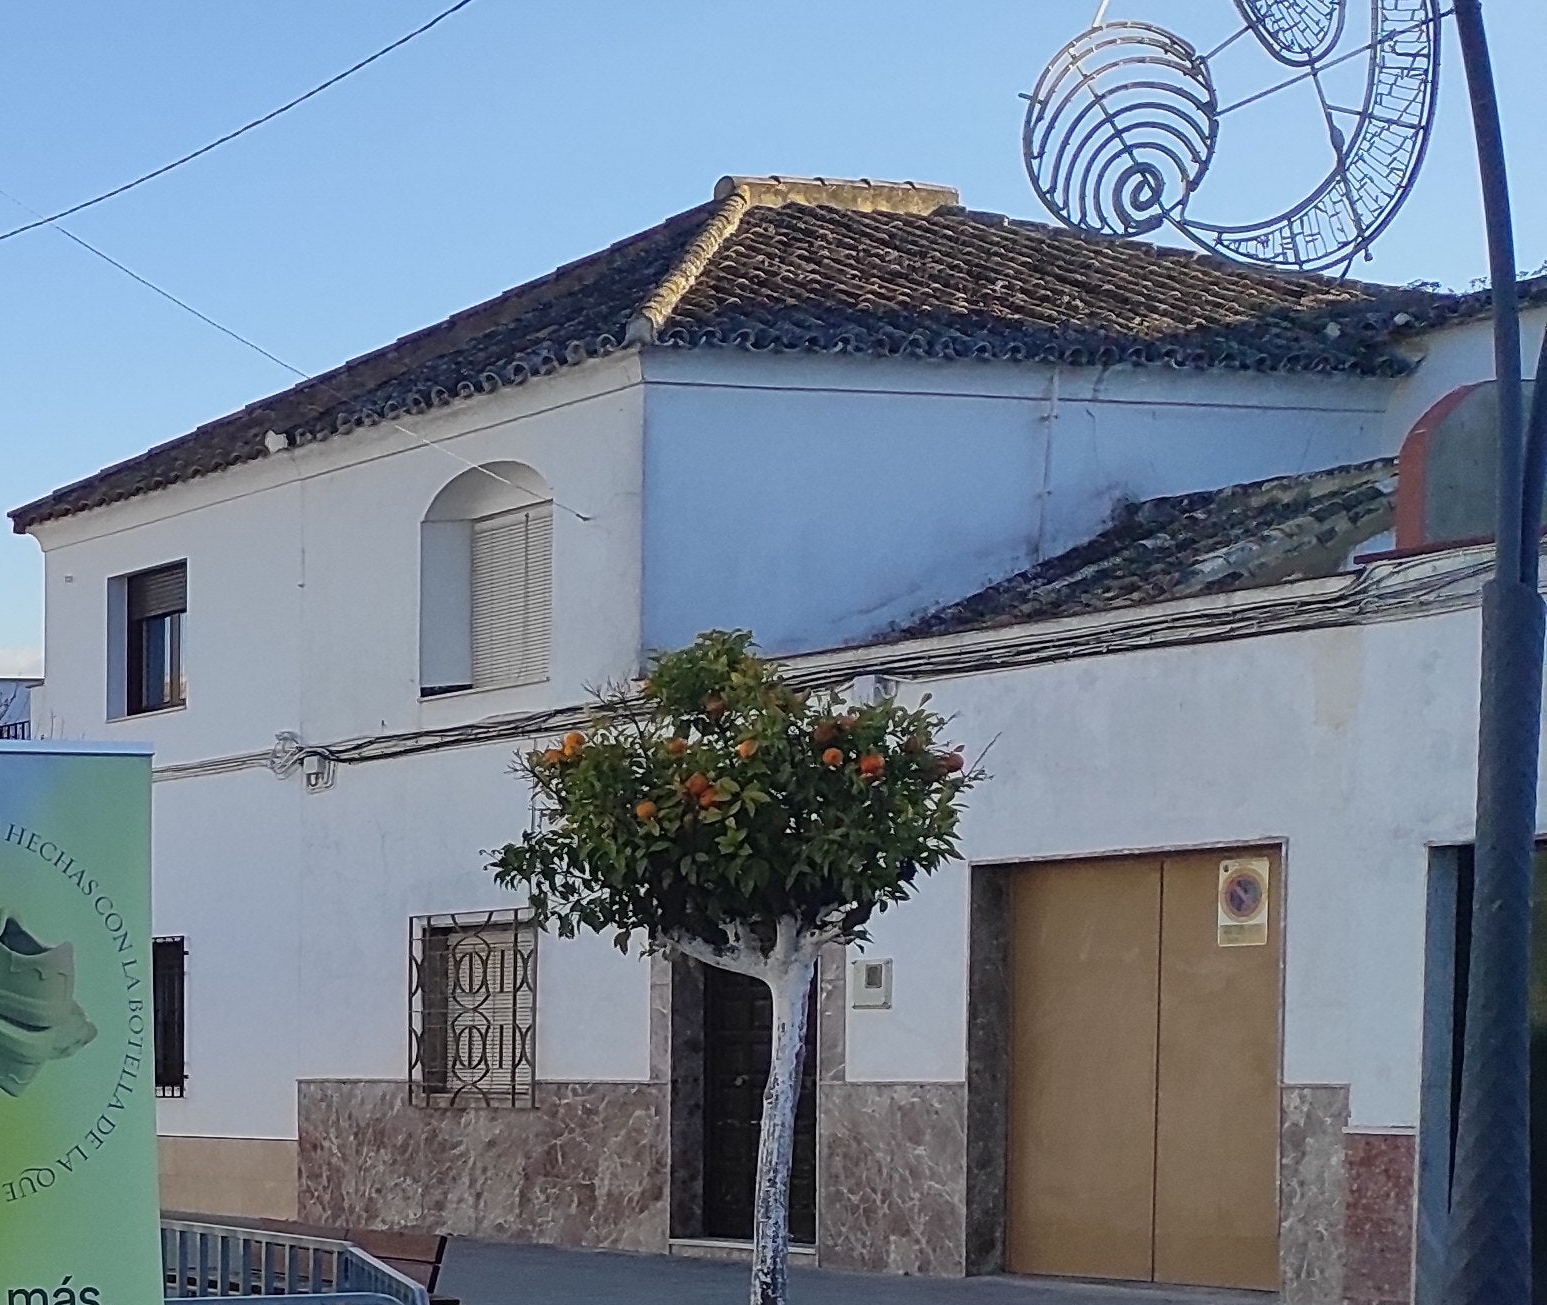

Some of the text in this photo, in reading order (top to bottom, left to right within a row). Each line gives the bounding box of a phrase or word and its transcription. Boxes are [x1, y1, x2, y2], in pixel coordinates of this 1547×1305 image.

[4, 823, 98, 896] HECHAS
[95, 896, 133, 952] CON
[121, 959, 141, 990] LA
[107, 1000, 144, 1109] BOTELLA
[84, 1113, 116, 1149] DE
[56, 1145, 89, 1172] LA
[2, 1167, 56, 1202] QUE
